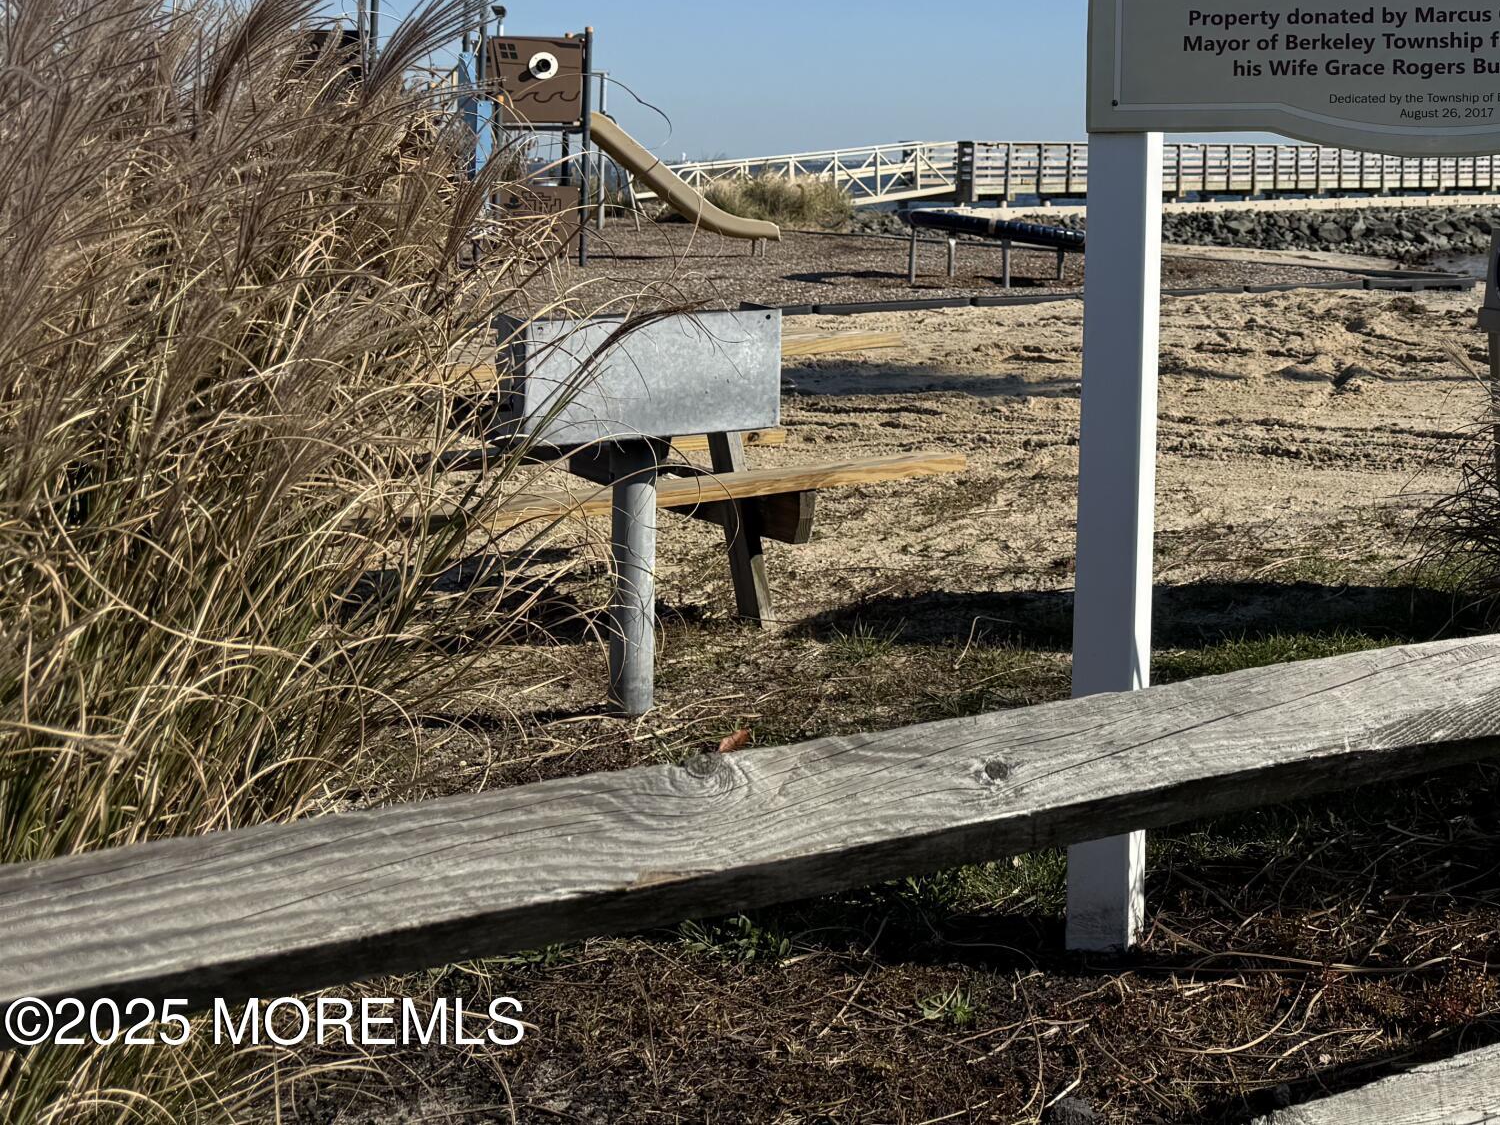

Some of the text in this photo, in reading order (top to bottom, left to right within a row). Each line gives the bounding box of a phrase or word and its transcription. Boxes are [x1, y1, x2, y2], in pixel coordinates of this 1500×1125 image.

[1188, 9, 1281, 29] Property
[1286, 7, 1374, 24] donated
[1382, 6, 1408, 27] by
[1414, 5, 1492, 24] Marcus
[1183, 35, 1250, 55] Mayor
[1256, 34, 1279, 51] of
[1285, 33, 1376, 54] Berkeley
[1382, 32, 1484, 53] Township
[1233, 59, 1262, 77] his
[1269, 59, 1318, 76] Wife
[1325, 59, 1385, 76] Grace
[1392, 58, 1466, 79] Rogers
[1329, 93, 1386, 104] Dedicated
[1389, 93, 1402, 106] by
[1405, 93, 1424, 103] the
[1428, 92, 1480, 105] Township
[1482, 92, 1495, 103] of
[1400, 107, 1494, 121] August 26, 2017
